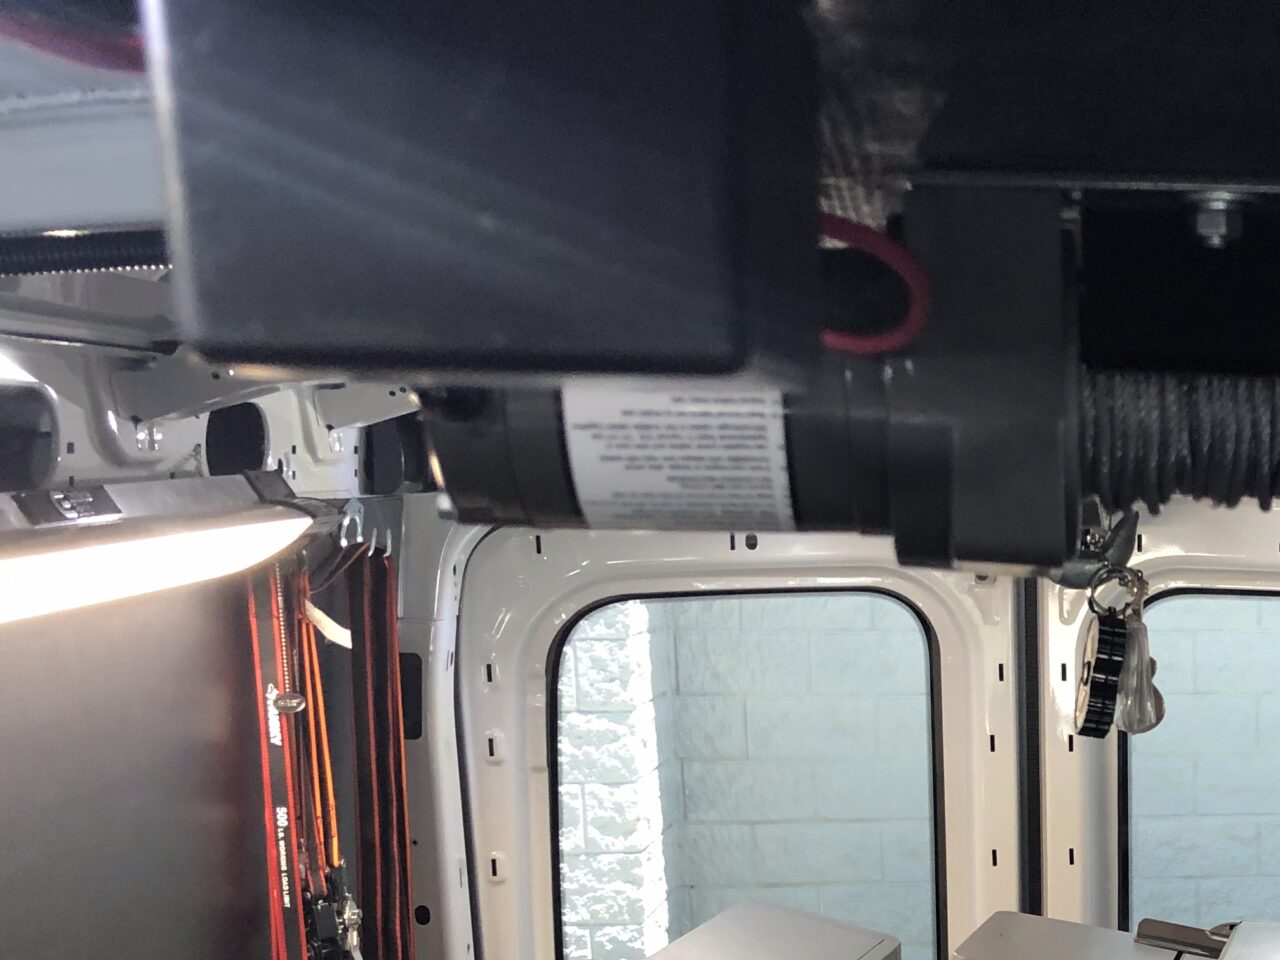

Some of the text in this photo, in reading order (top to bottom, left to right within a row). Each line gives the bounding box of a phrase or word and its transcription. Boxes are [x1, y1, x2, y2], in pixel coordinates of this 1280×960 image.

[276, 807, 288, 827] 500
[278, 840, 287, 871] WORKING
[281, 873, 290, 890] LOAD
[282, 891, 291, 908] LIMIT
